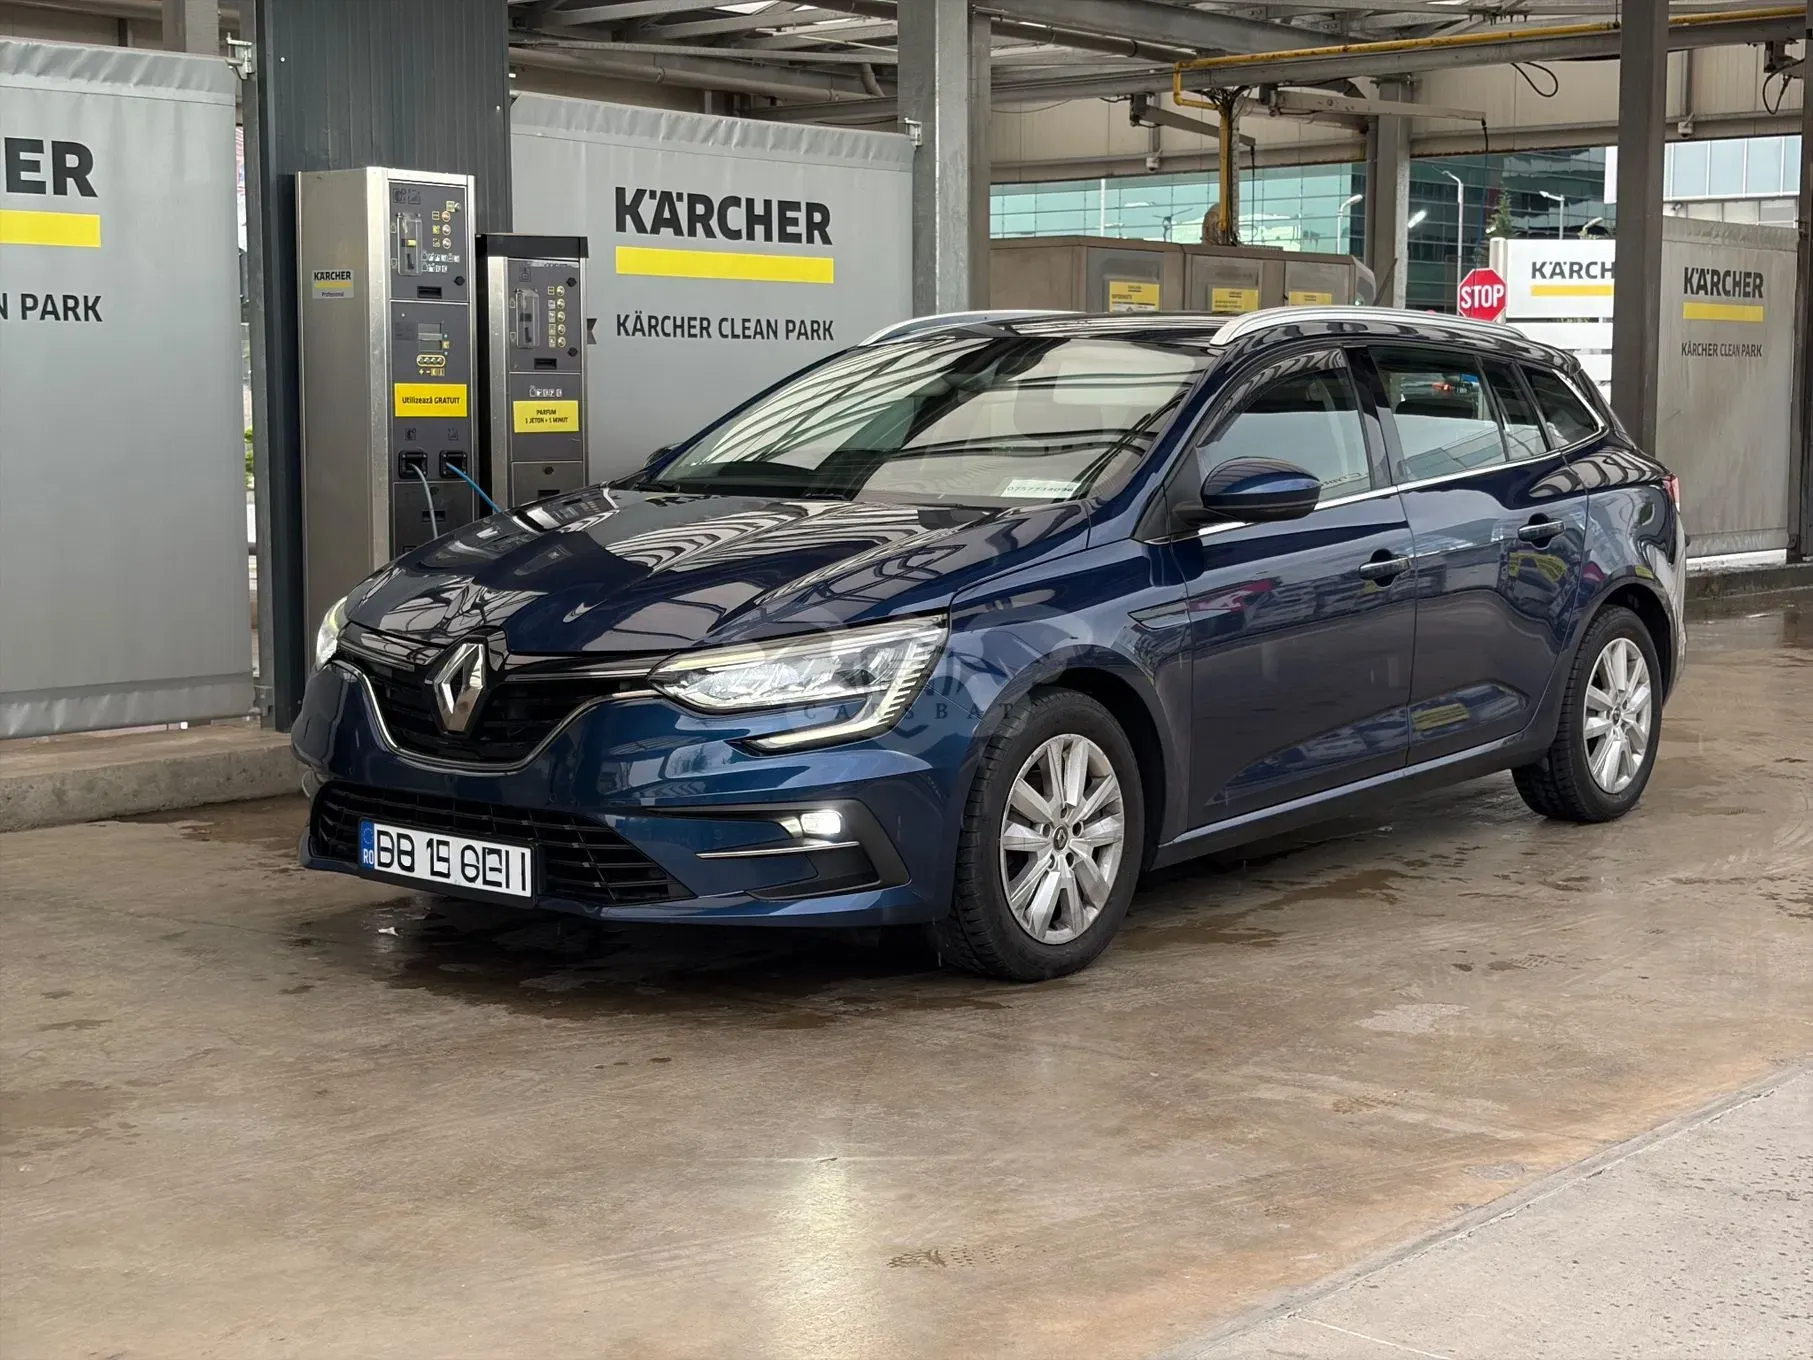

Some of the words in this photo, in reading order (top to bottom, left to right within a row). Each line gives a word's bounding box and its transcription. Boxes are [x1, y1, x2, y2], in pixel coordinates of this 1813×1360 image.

[615, 186, 833, 246] KÄRCHER
[1460, 284, 1505, 309] STOP
[1683, 267, 1764, 299] KÄRCHER
[20, 293, 103, 323] PARK
[616, 310, 712, 339] KÄRCHER
[718, 317, 778, 340] CLEAN
[785, 319, 834, 341] PARK
[1681, 341, 1719, 357] KÄRCHER
[1719, 343, 1741, 358] CLEAN
[1741, 344, 1763, 358] PARK
[433, 396, 461, 405] GRATUIT
[363, 848, 375, 865] RO
